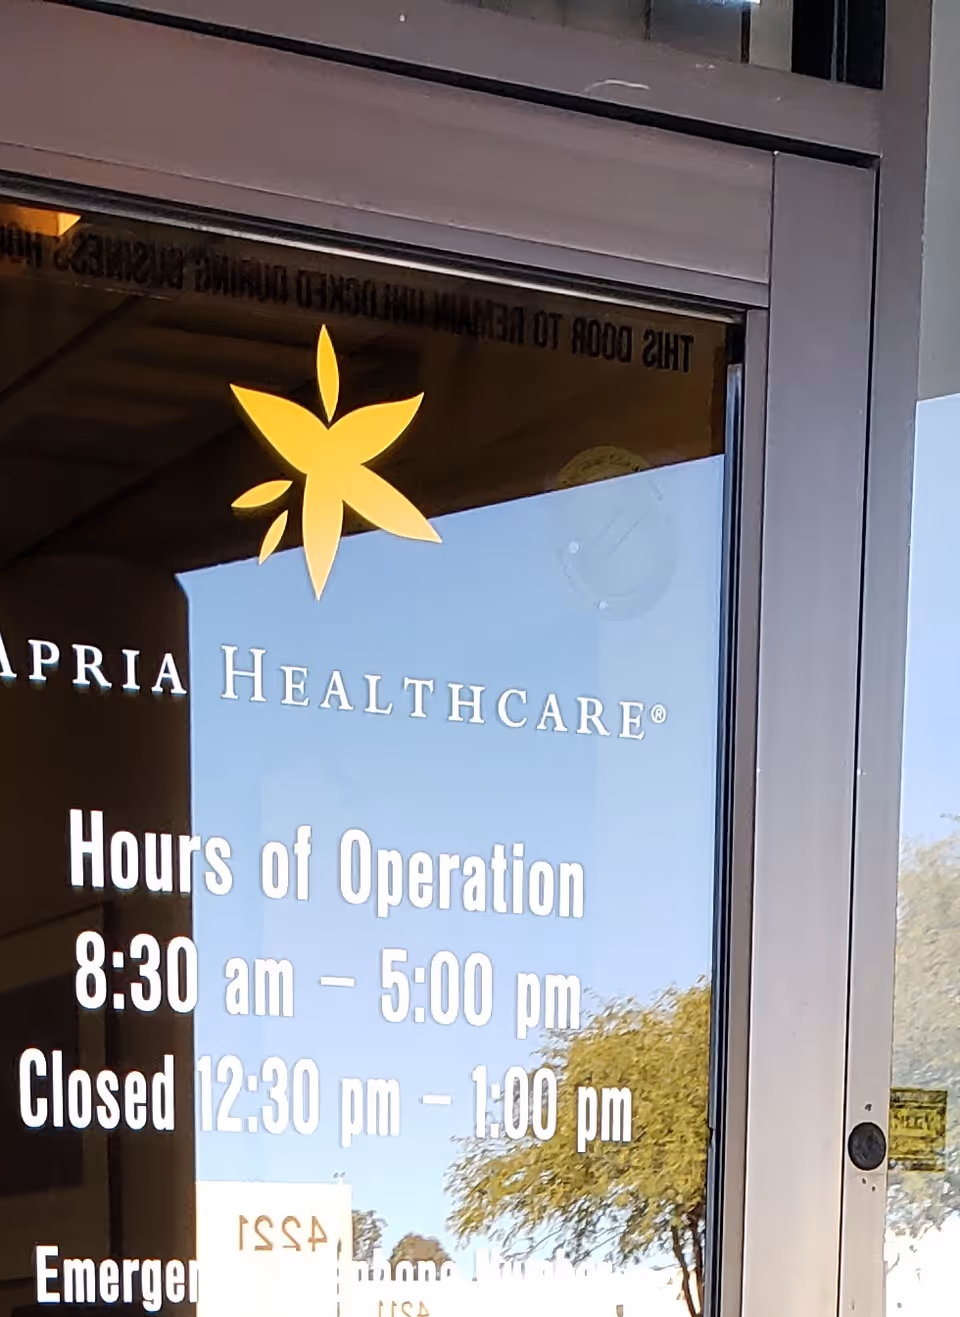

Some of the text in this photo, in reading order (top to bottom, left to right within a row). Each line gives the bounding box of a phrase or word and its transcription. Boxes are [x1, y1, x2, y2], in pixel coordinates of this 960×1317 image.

[68, 808, 586, 920] Hours of Operation
[74, 931, 199, 1014] 8:30
[223, 954, 295, 1018] am
[379, 949, 494, 1027] 5:00
[515, 968, 583, 1040] pm
[18, 1048, 177, 1131] Closed
[197, 1054, 320, 1137] 12:30
[341, 1078, 402, 1149] pm
[471, 1065, 560, 1142] 1:00
[576, 1086, 634, 1153] pm
